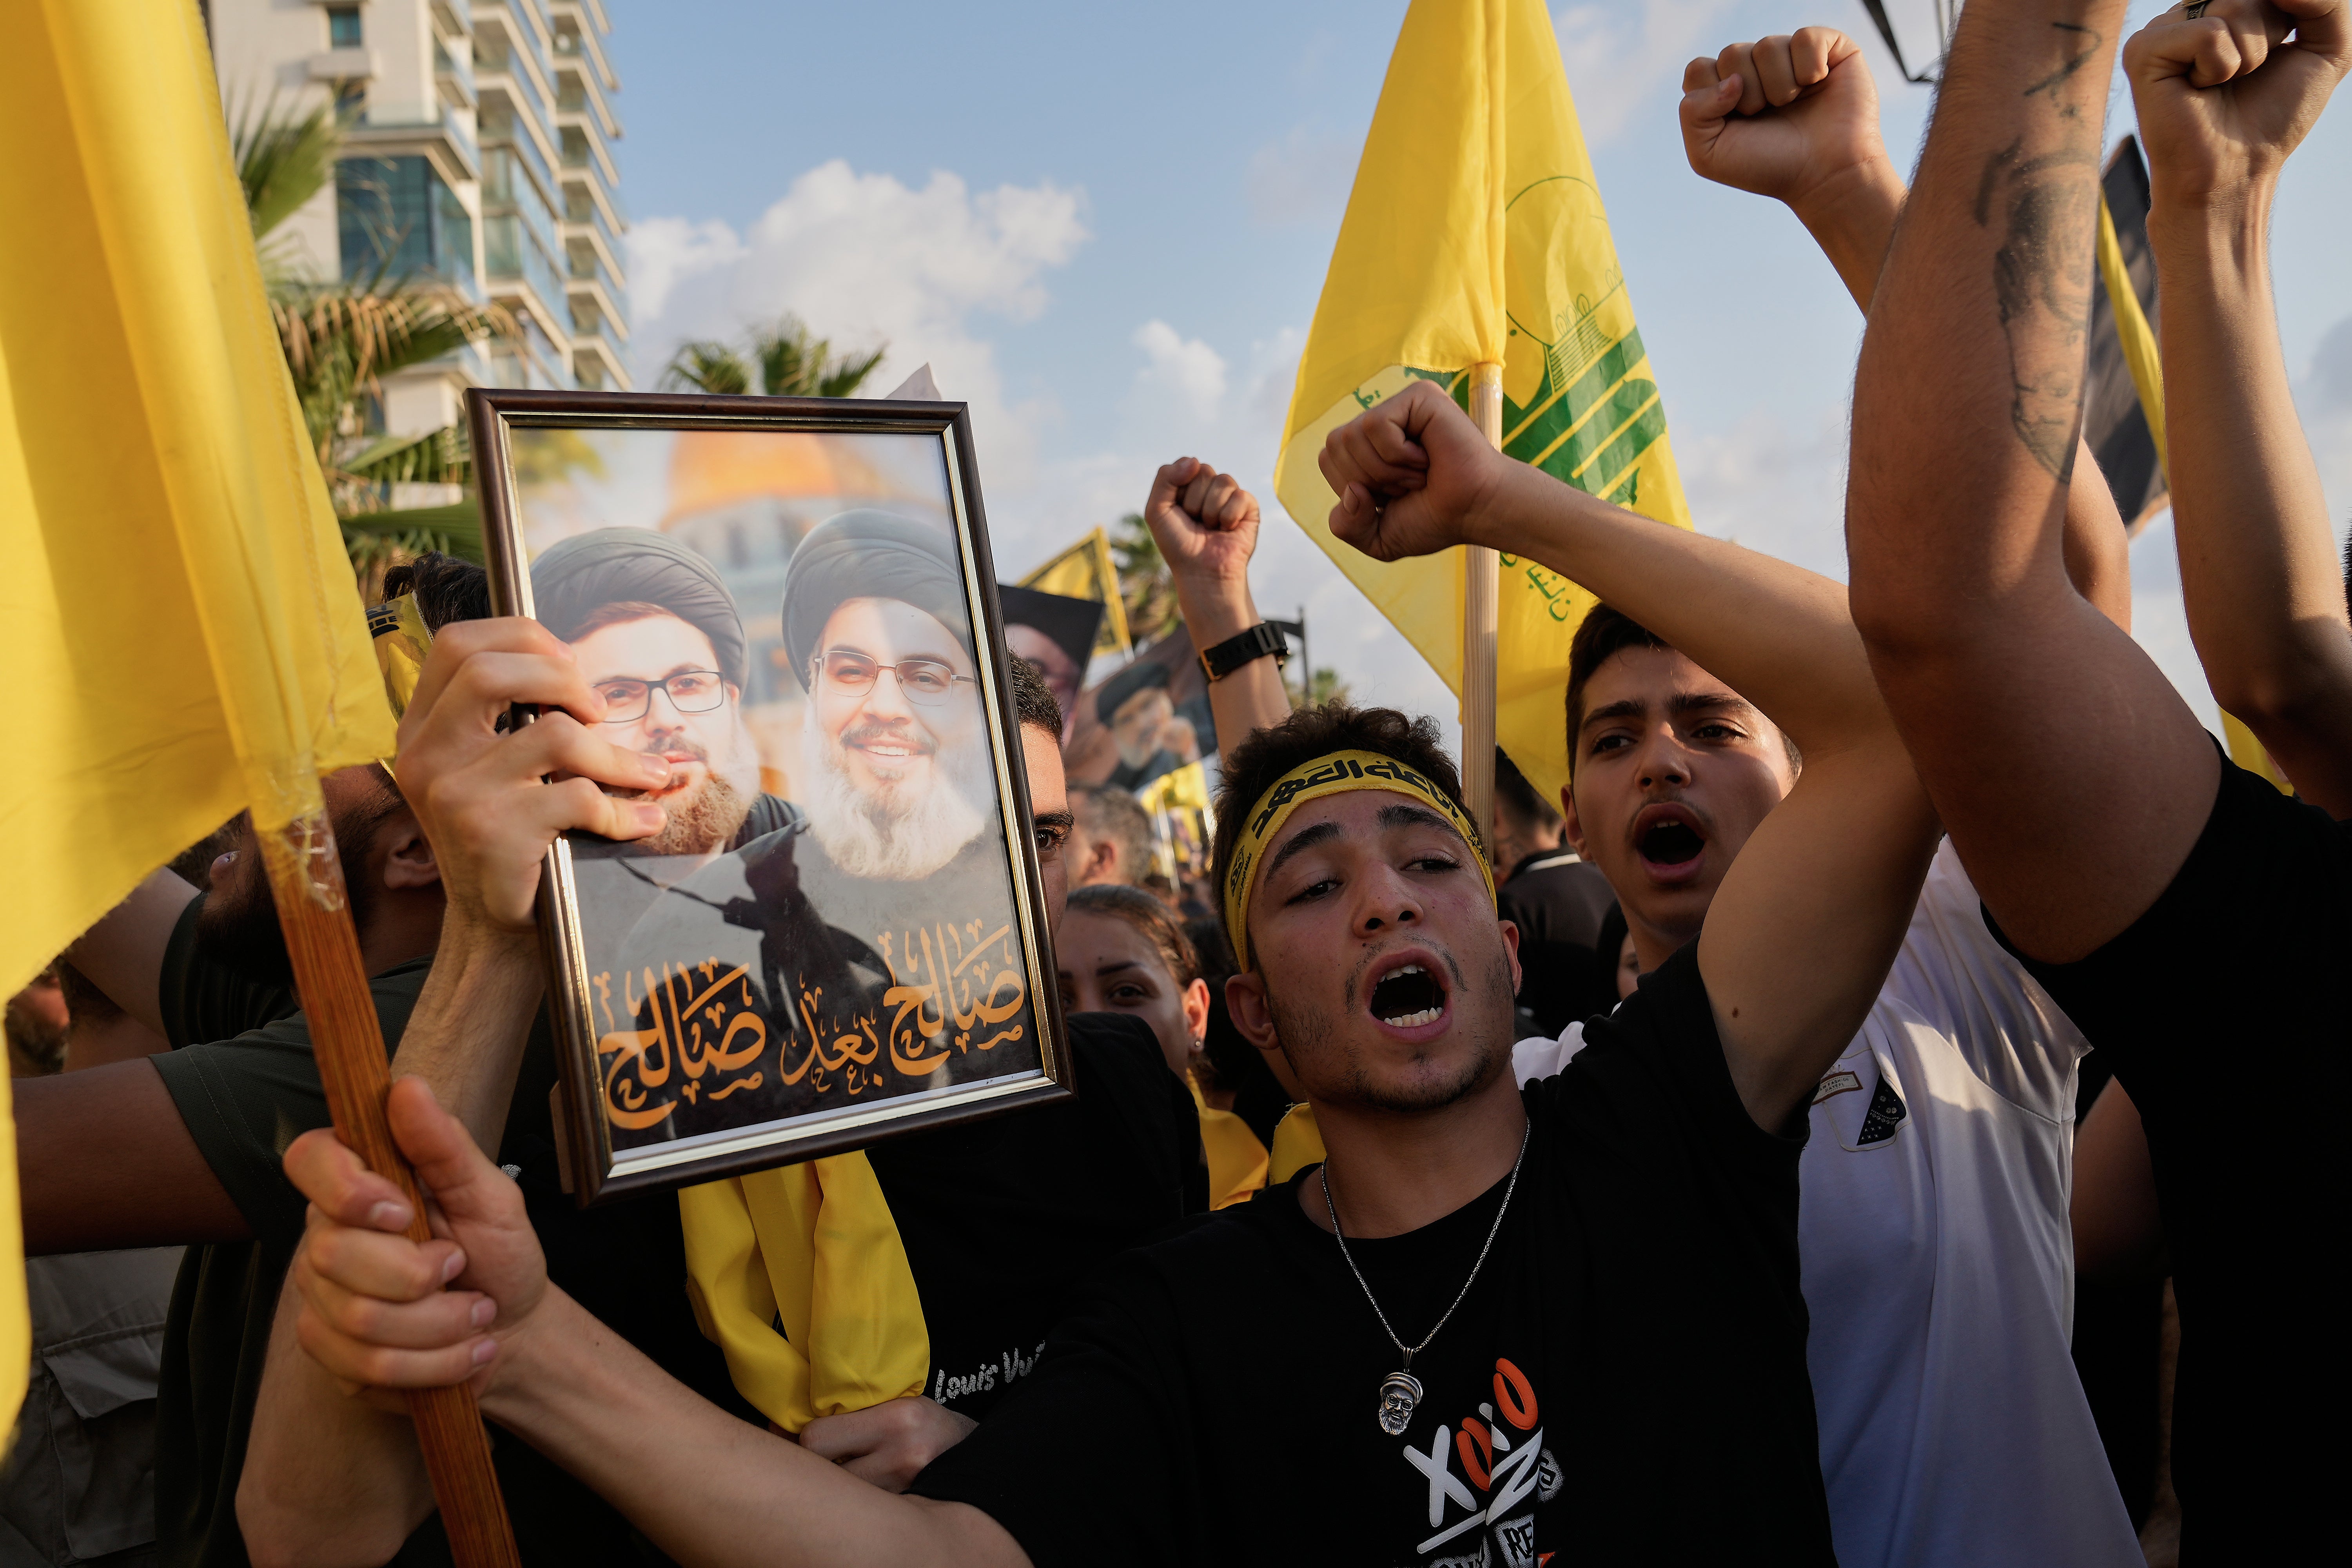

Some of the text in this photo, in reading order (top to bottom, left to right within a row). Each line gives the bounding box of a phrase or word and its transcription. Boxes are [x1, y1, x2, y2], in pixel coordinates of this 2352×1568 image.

[1251, 759, 1365, 840] العهد
[593, 918, 1025, 1130] صالح بعد صالح
[935, 1363, 998, 1404] Louis
